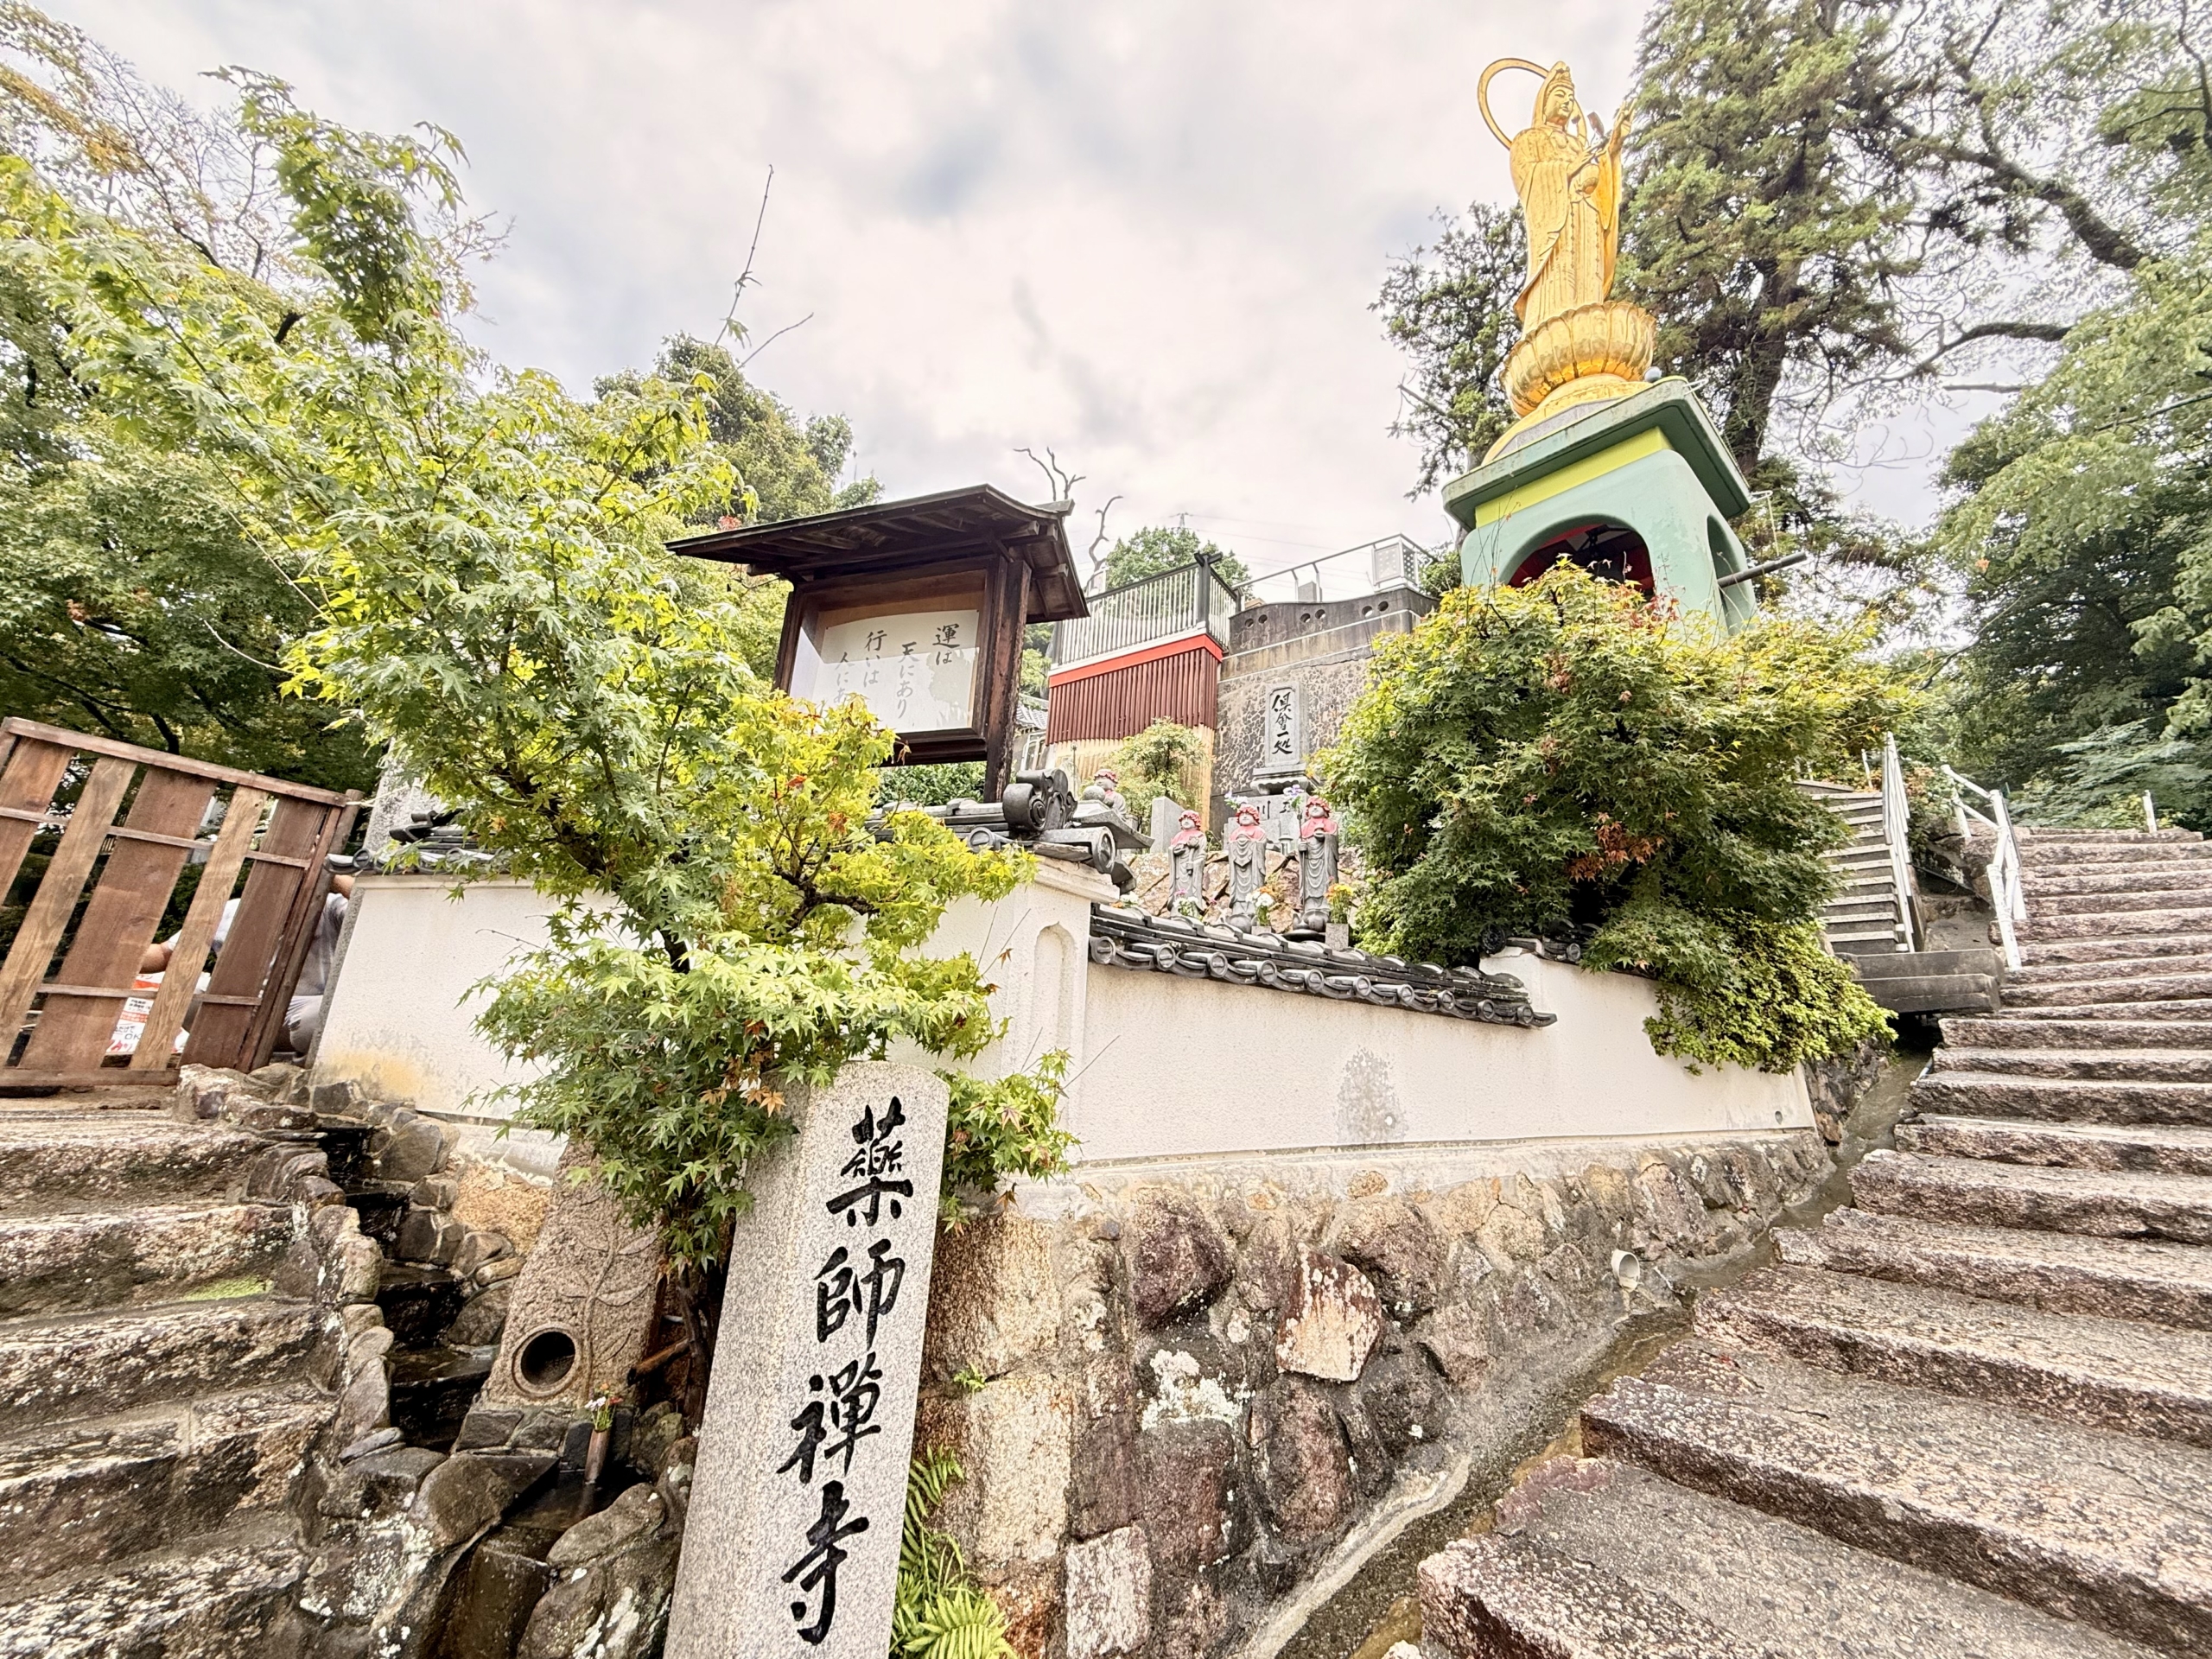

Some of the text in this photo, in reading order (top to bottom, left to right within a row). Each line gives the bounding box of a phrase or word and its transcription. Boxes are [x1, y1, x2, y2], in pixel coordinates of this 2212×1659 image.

[863, 630, 887, 688] 行いは
[932, 623, 960, 665] 運は
[896, 641, 919, 718] 天にあり
